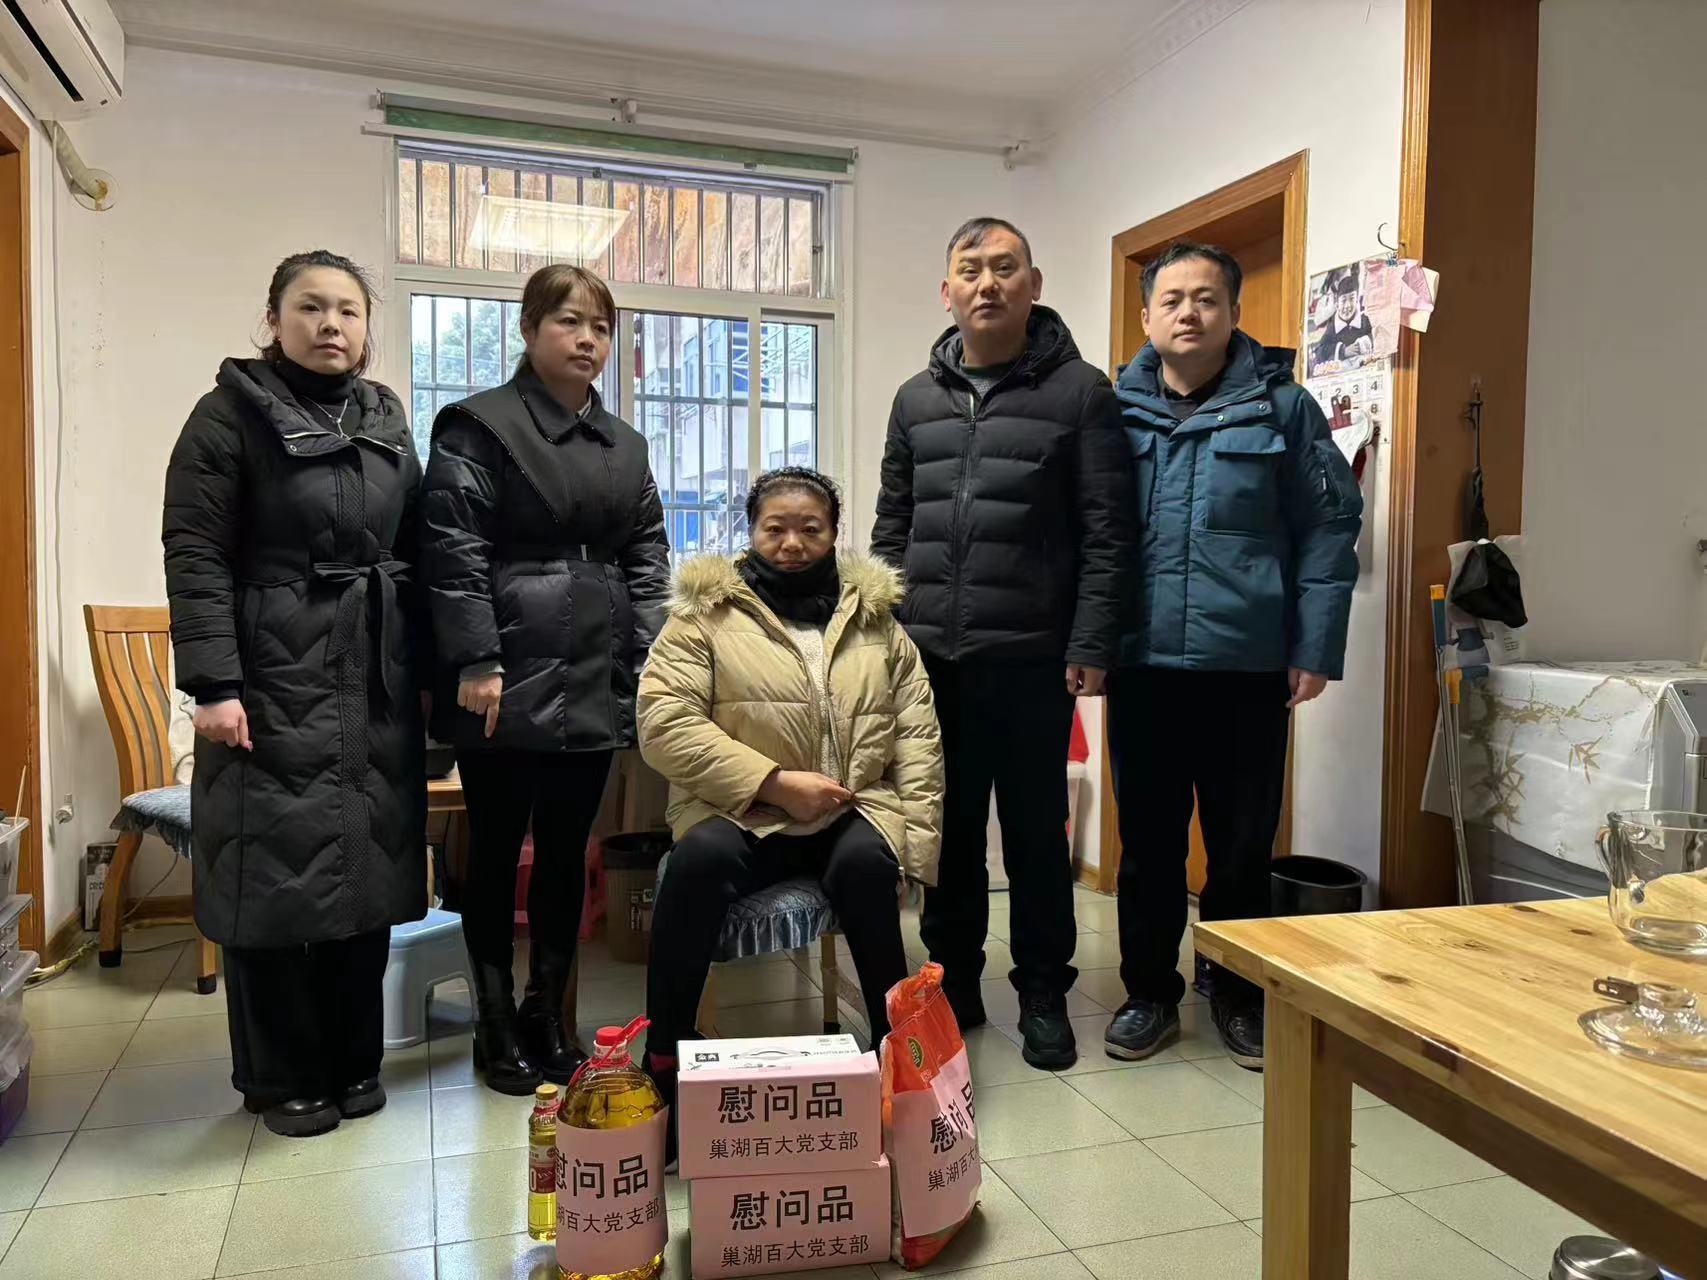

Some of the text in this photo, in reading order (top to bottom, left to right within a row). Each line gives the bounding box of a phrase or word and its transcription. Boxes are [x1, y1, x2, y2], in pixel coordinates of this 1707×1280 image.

[1352, 384, 1359, 394] 3
[1370, 381, 1378, 391] 4
[717, 1081, 843, 1124] 慰问品
[709, 1131, 859, 1160] 巢湖百大党支部
[927, 1144, 979, 1192] 巢湖百大
[730, 1185, 853, 1231] 慰问品
[721, 1234, 869, 1268] 巢湖百大党支部
